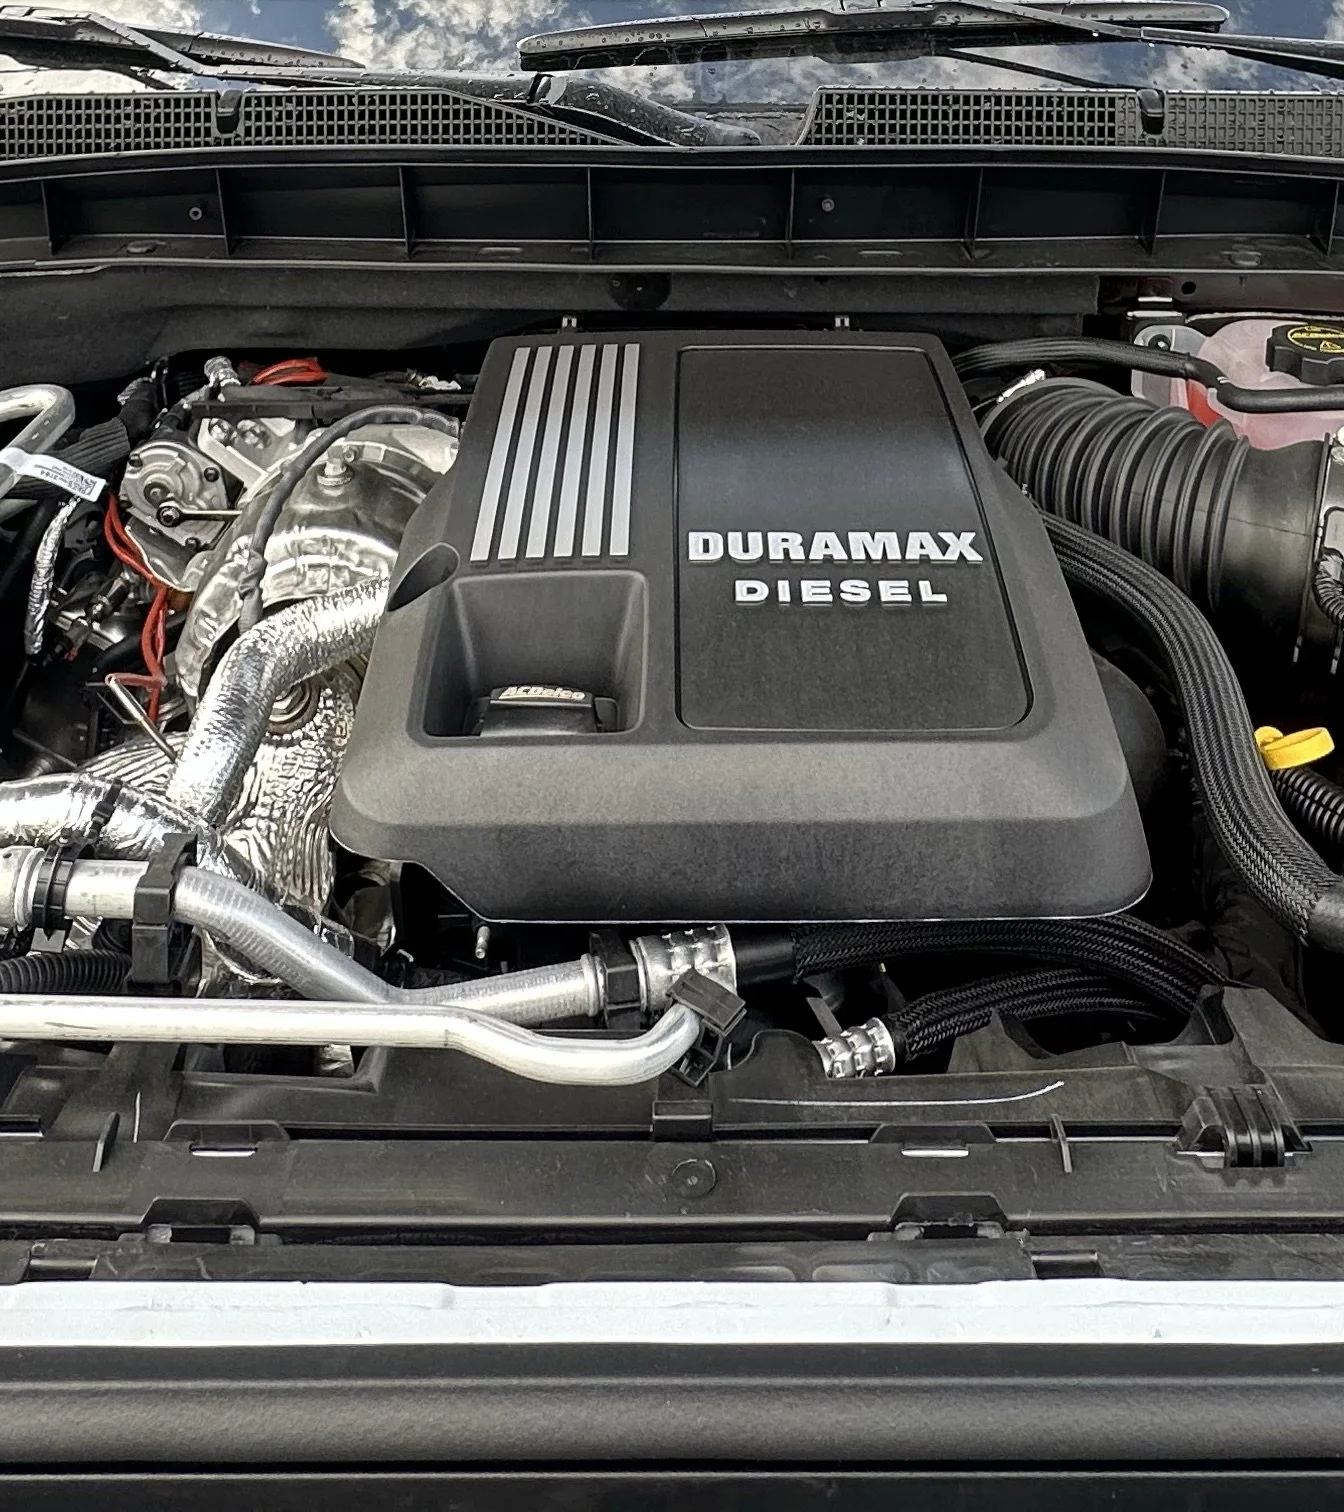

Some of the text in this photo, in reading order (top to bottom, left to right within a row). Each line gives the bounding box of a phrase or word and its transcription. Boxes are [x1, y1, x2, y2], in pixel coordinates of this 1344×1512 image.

[687, 531, 984, 562] DURAMAX
[735, 580, 948, 603] DIESEL
[499, 686, 586, 701] ACDelco
